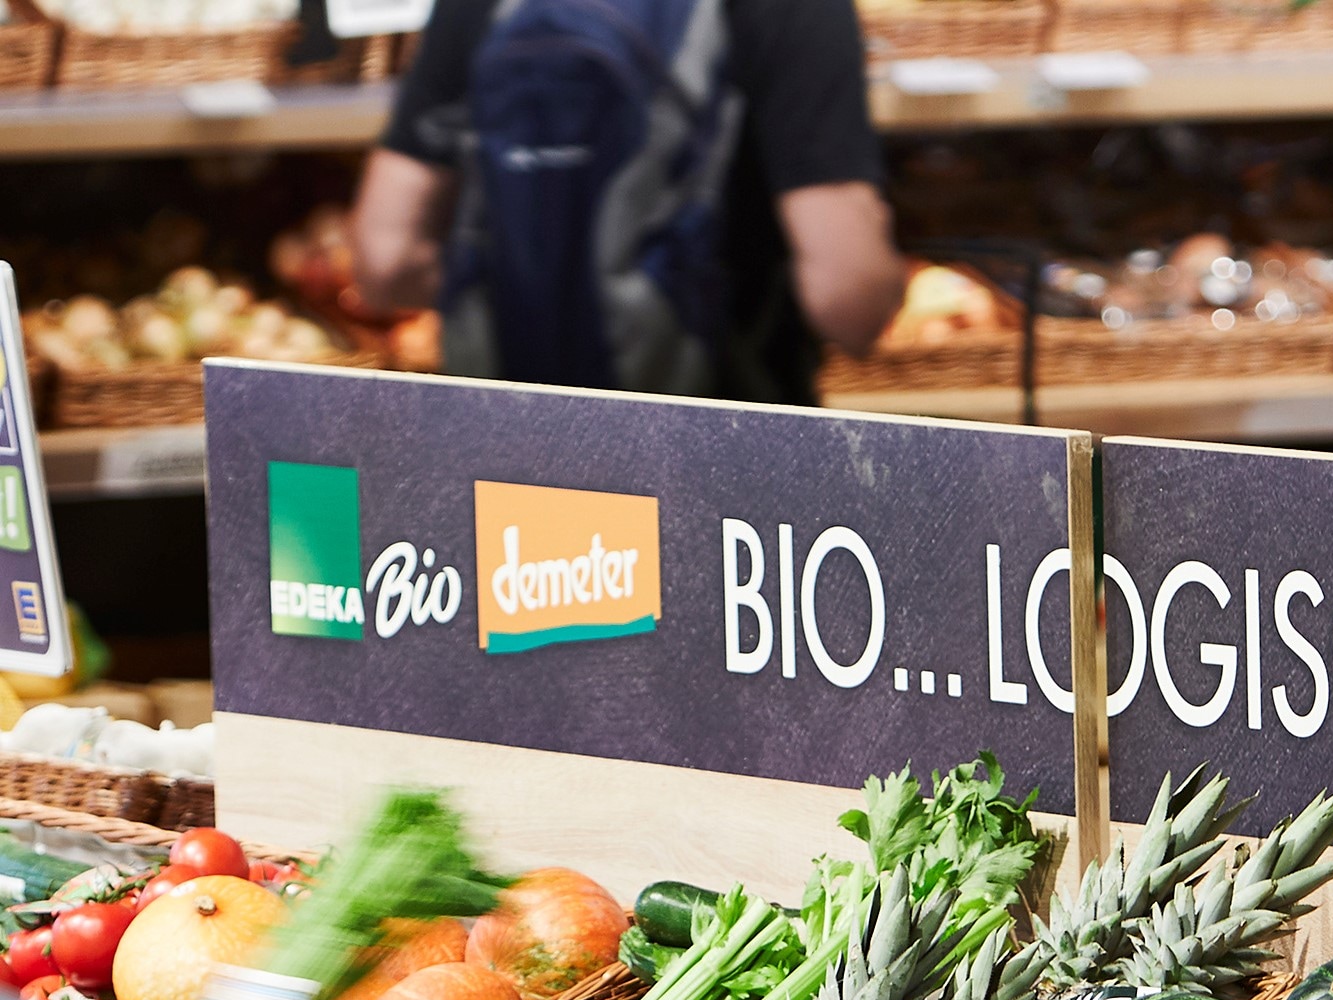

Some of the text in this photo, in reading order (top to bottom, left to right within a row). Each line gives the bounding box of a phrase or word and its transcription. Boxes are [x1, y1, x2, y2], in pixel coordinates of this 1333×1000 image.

[270, 540, 463, 638] EDEKA Bio
[491, 525, 640, 615] demeter
